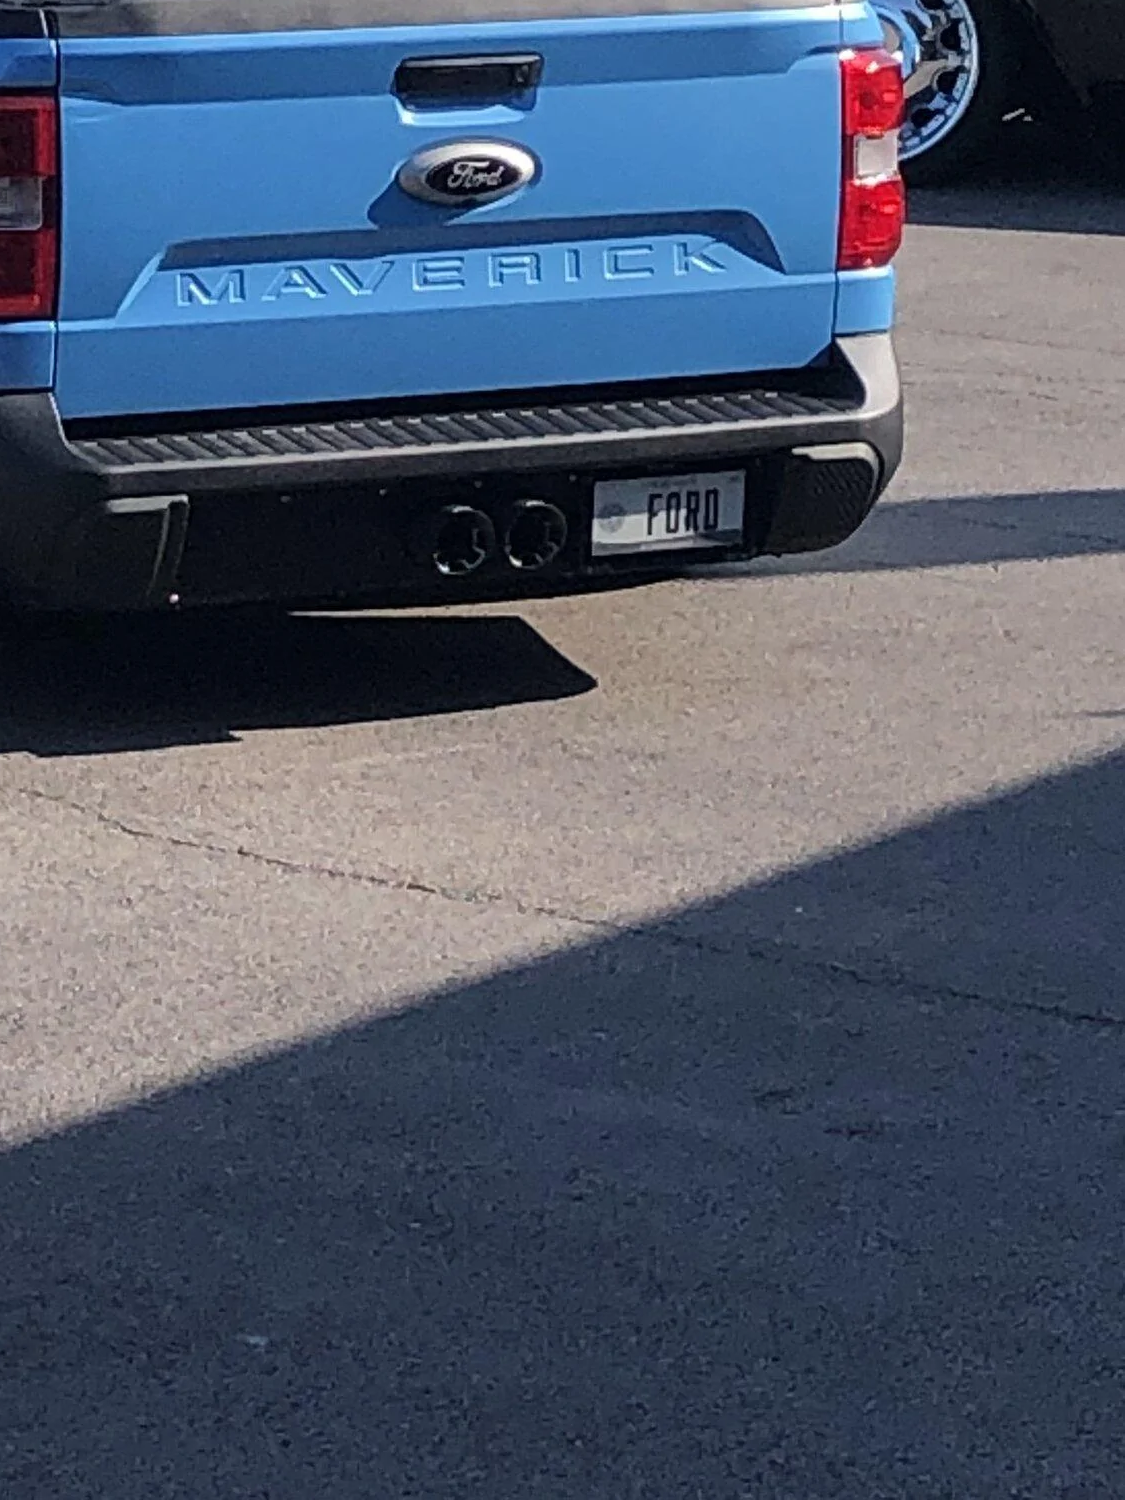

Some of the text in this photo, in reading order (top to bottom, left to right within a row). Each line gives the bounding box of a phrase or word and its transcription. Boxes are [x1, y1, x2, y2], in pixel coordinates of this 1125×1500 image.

[447, 160, 505, 189] Ford
[176, 242, 728, 307] MAVERICK
[646, 486, 719, 536] FORD
